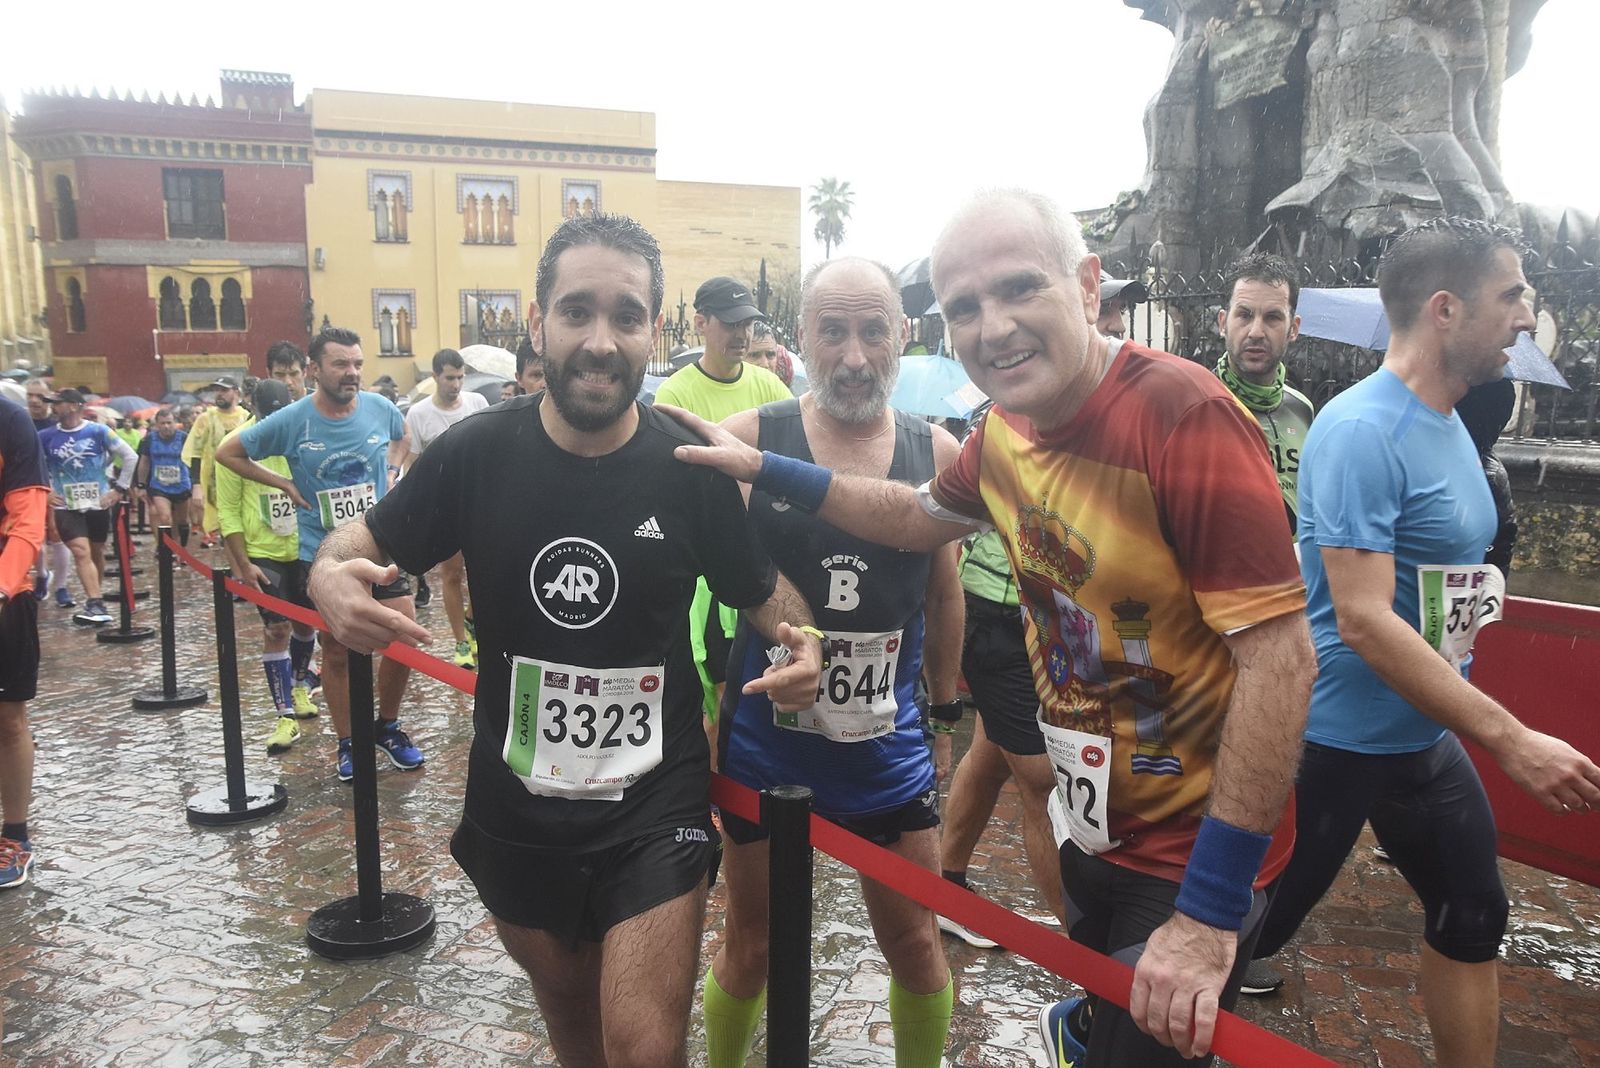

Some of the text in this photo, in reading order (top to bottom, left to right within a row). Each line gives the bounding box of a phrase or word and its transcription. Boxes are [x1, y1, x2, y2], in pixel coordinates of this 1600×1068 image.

[334, 496, 375, 519] 5045
[634, 528, 665, 540] adidas
[546, 546, 605, 569] ADIDAS RUNNERS
[821, 554, 869, 572] serie
[542, 563, 600, 604] AR
[824, 568, 861, 611] B
[558, 610, 587, 620] MADRID
[602, 684, 635, 692] MARATÓN
[519, 704, 530, 746] CAJÓN
[543, 698, 652, 749] 3323
[1055, 739, 1076, 750] MEDIA
[584, 777, 623, 785] Cruzcampo
